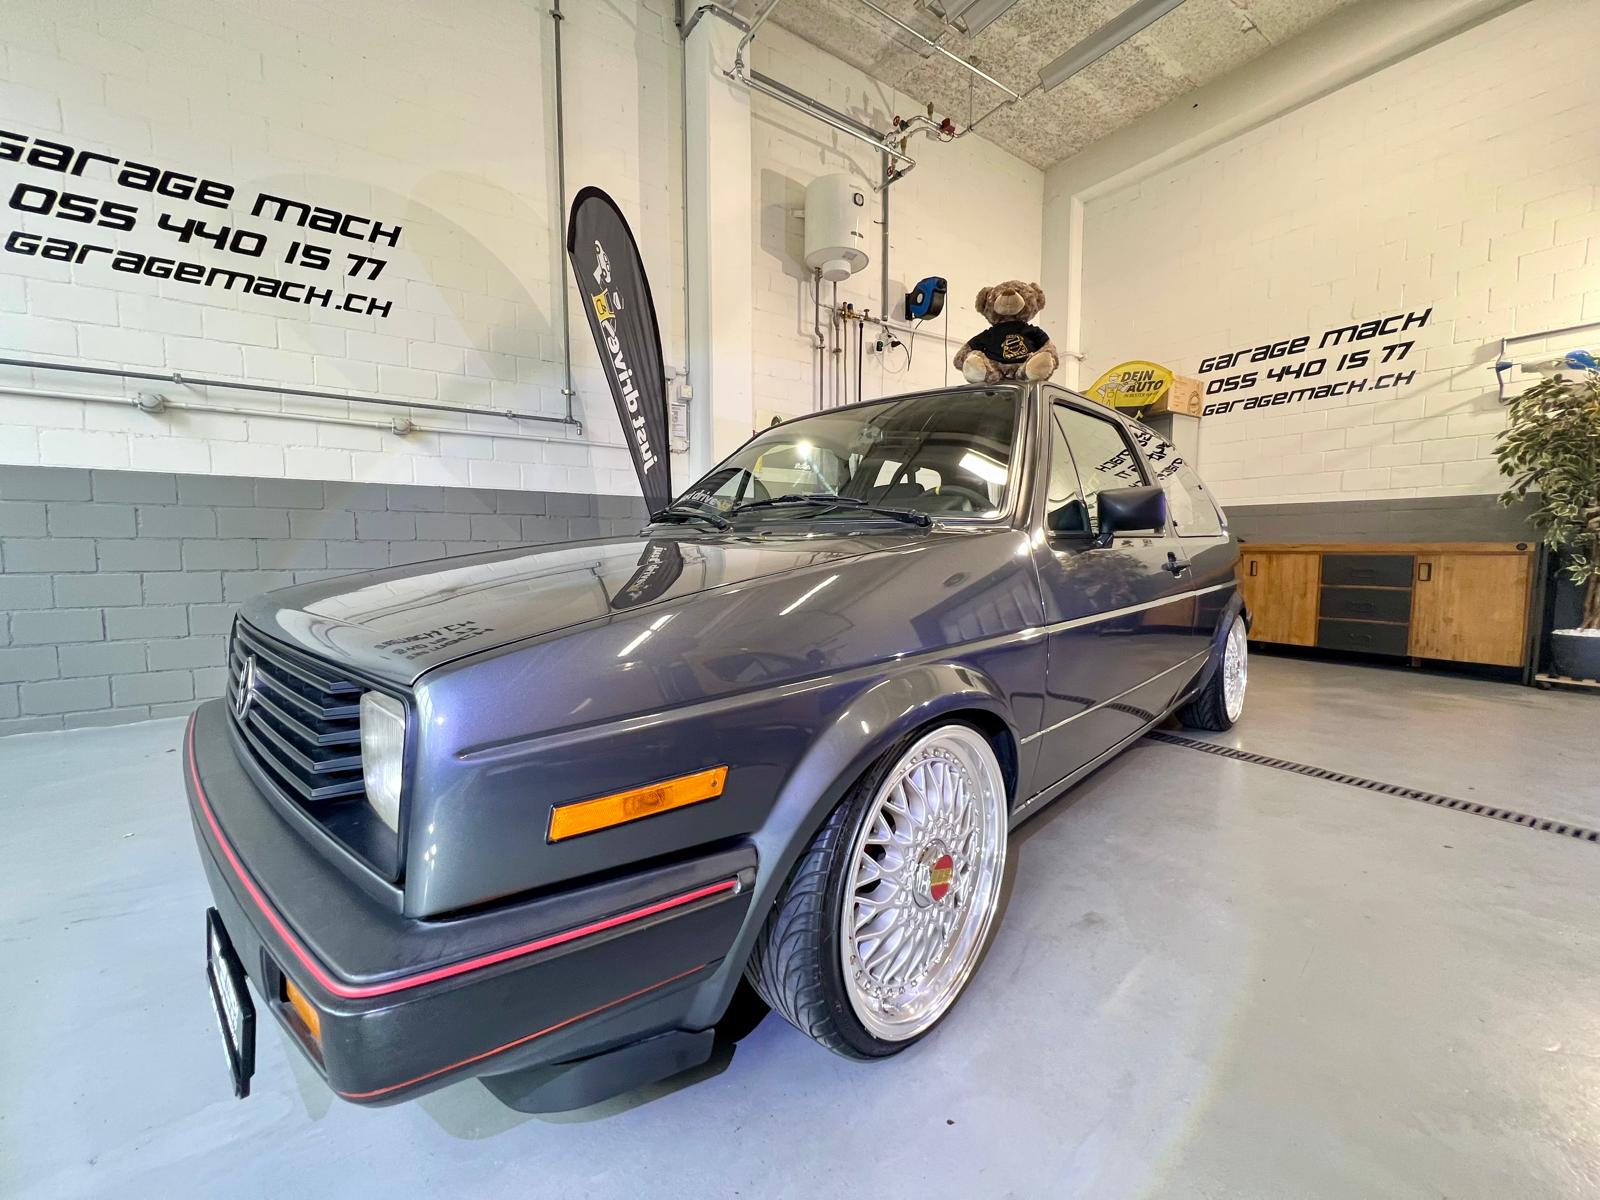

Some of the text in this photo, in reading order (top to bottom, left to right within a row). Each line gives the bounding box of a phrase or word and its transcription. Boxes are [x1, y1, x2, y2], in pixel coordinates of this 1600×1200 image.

[9, 183, 138, 231] 055
[158, 214, 267, 257] 440
[347, 253, 387, 280] 77
[1120, 370, 1154, 383] DEIN
[1206, 375, 1256, 395] 055
[1267, 358, 1327, 383] 440
[1380, 341, 1414, 363] 77
[1127, 380, 1164, 393] AUTO
